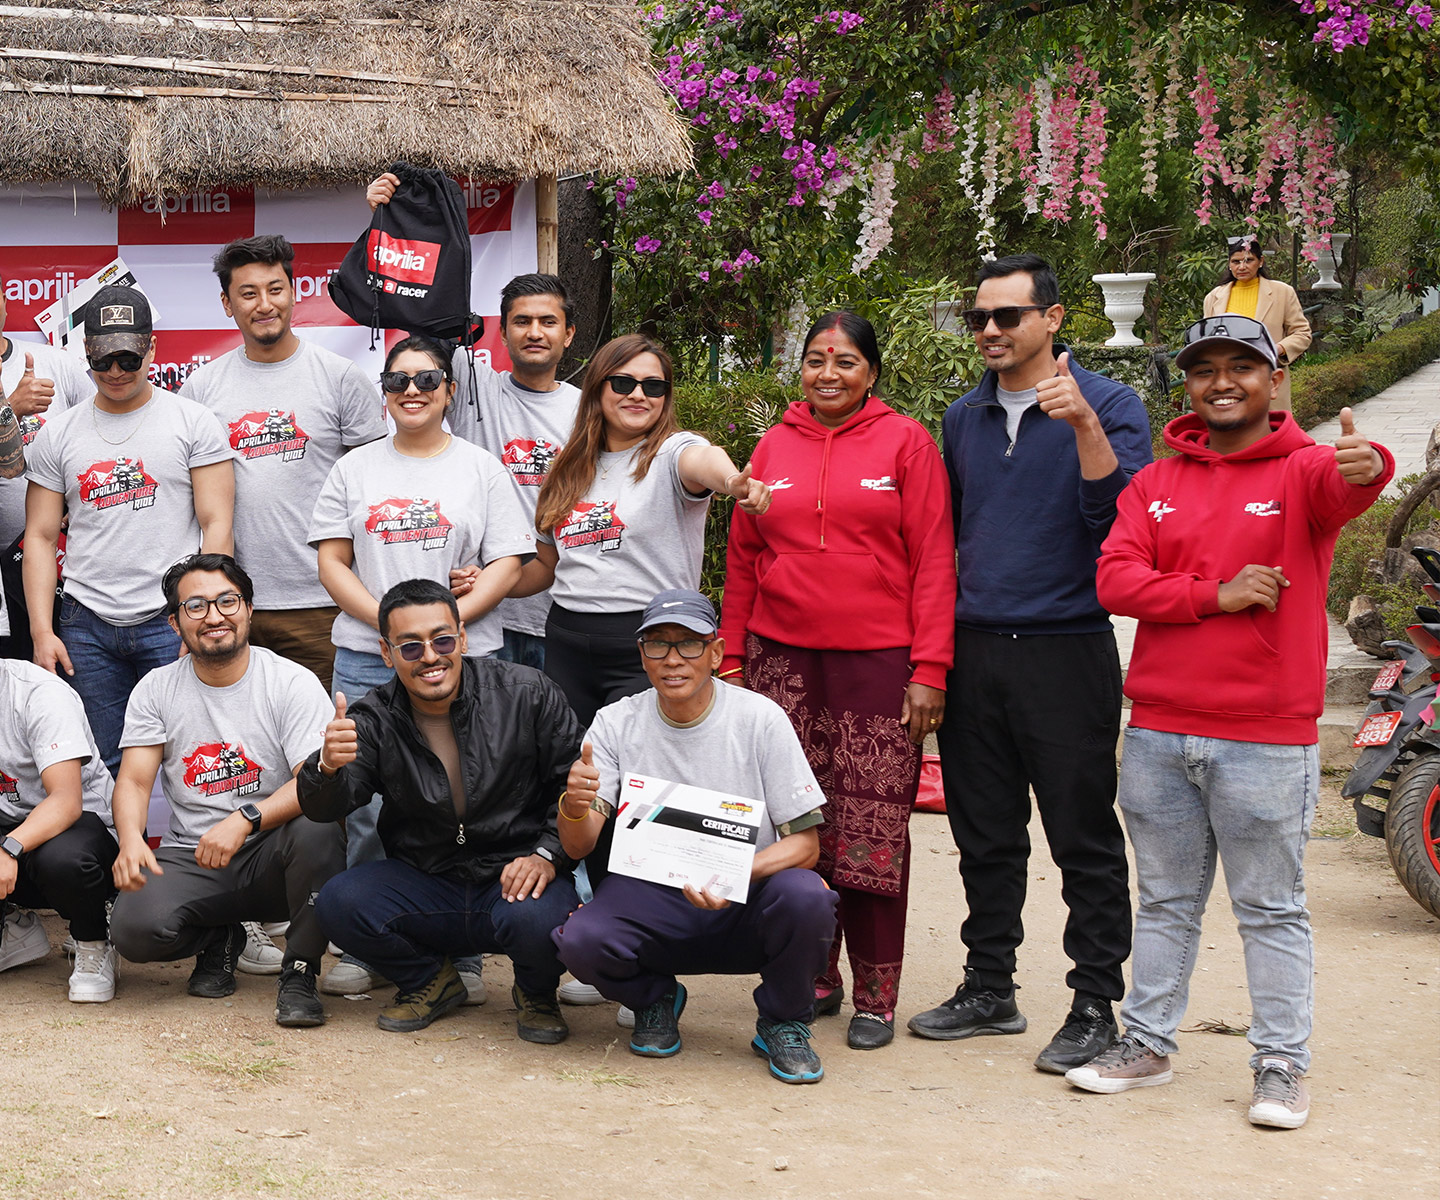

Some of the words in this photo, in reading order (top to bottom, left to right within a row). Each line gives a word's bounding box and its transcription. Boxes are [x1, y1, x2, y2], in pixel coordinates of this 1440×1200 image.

[463, 181, 500, 208] ilia
[373, 245, 426, 272] aprilia
[385, 282, 394, 291] a
[397, 285, 428, 298] racer
[238, 433, 271, 450] APRILIA
[248, 438, 306, 458] ADVENTURE
[284, 449, 304, 461] RIDE
[510, 463, 535, 474] PRILIA
[89, 481, 120, 500] APRILIA
[99, 485, 155, 509] ADVENTURE
[134, 496, 154, 509] RIDE
[375, 519, 412, 532] APRILIA
[386, 525, 449, 543] ADVENTURE
[424, 537, 447, 549] RIDE
[568, 526, 621, 547] ADVENTURE
[602, 538, 620, 551] RIDE
[195, 767, 227, 786] APRILIA
[239, 780, 260, 796] RIDE
[702, 818, 751, 838] CERTIFICATE
